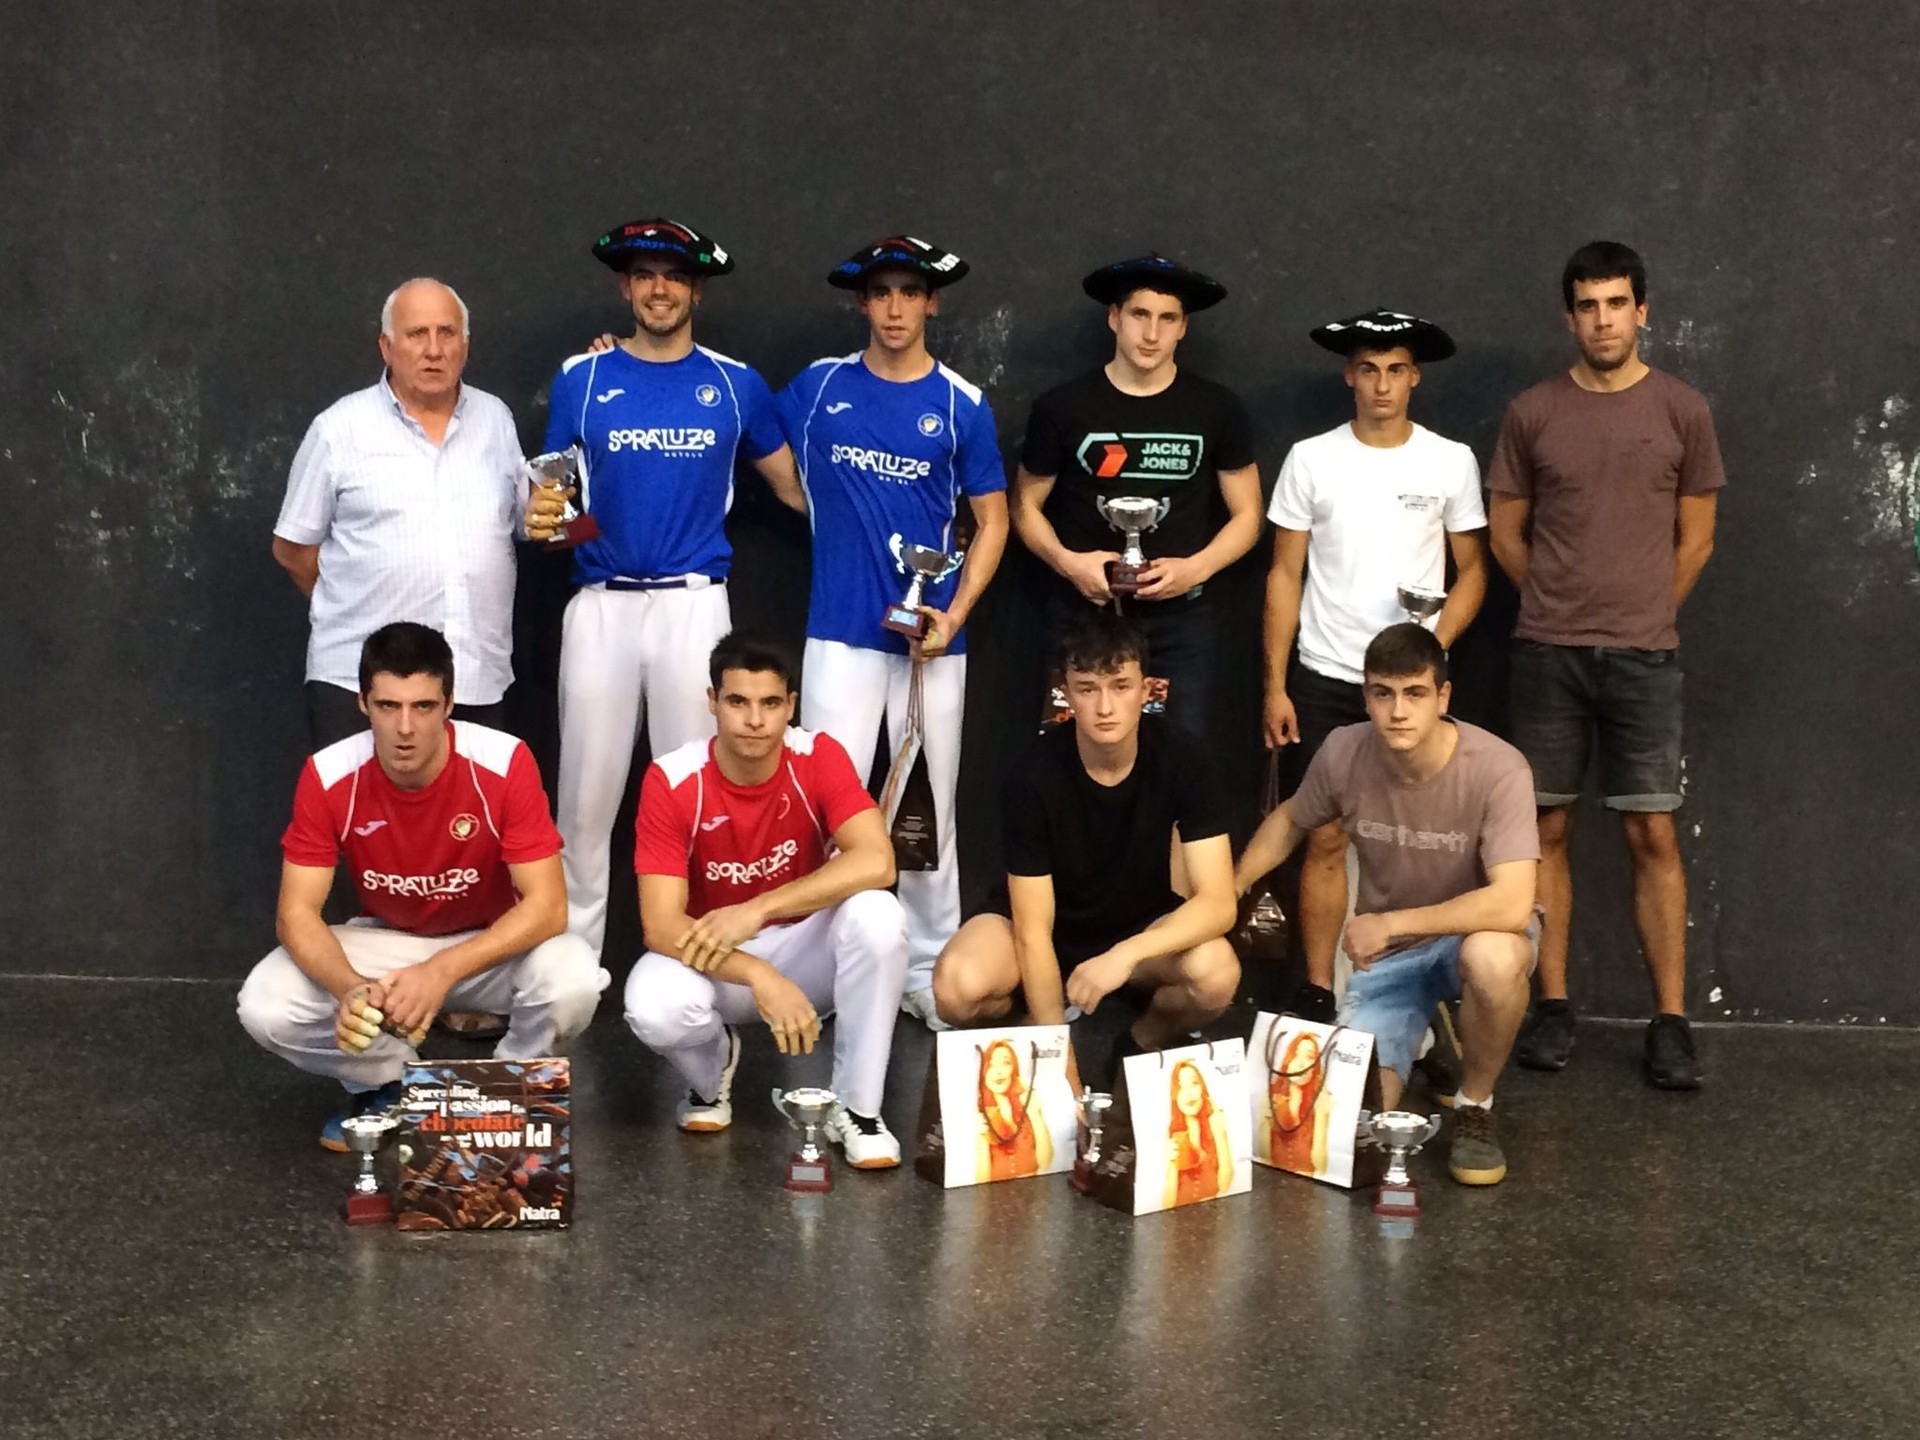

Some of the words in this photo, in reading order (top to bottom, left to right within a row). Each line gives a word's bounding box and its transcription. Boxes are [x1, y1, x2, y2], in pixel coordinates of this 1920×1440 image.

[1141, 442, 1191, 456] JACK&
[1139, 457, 1188, 470] JONES
[473, 1123, 552, 1148] world
[519, 1206, 560, 1220] Natra
